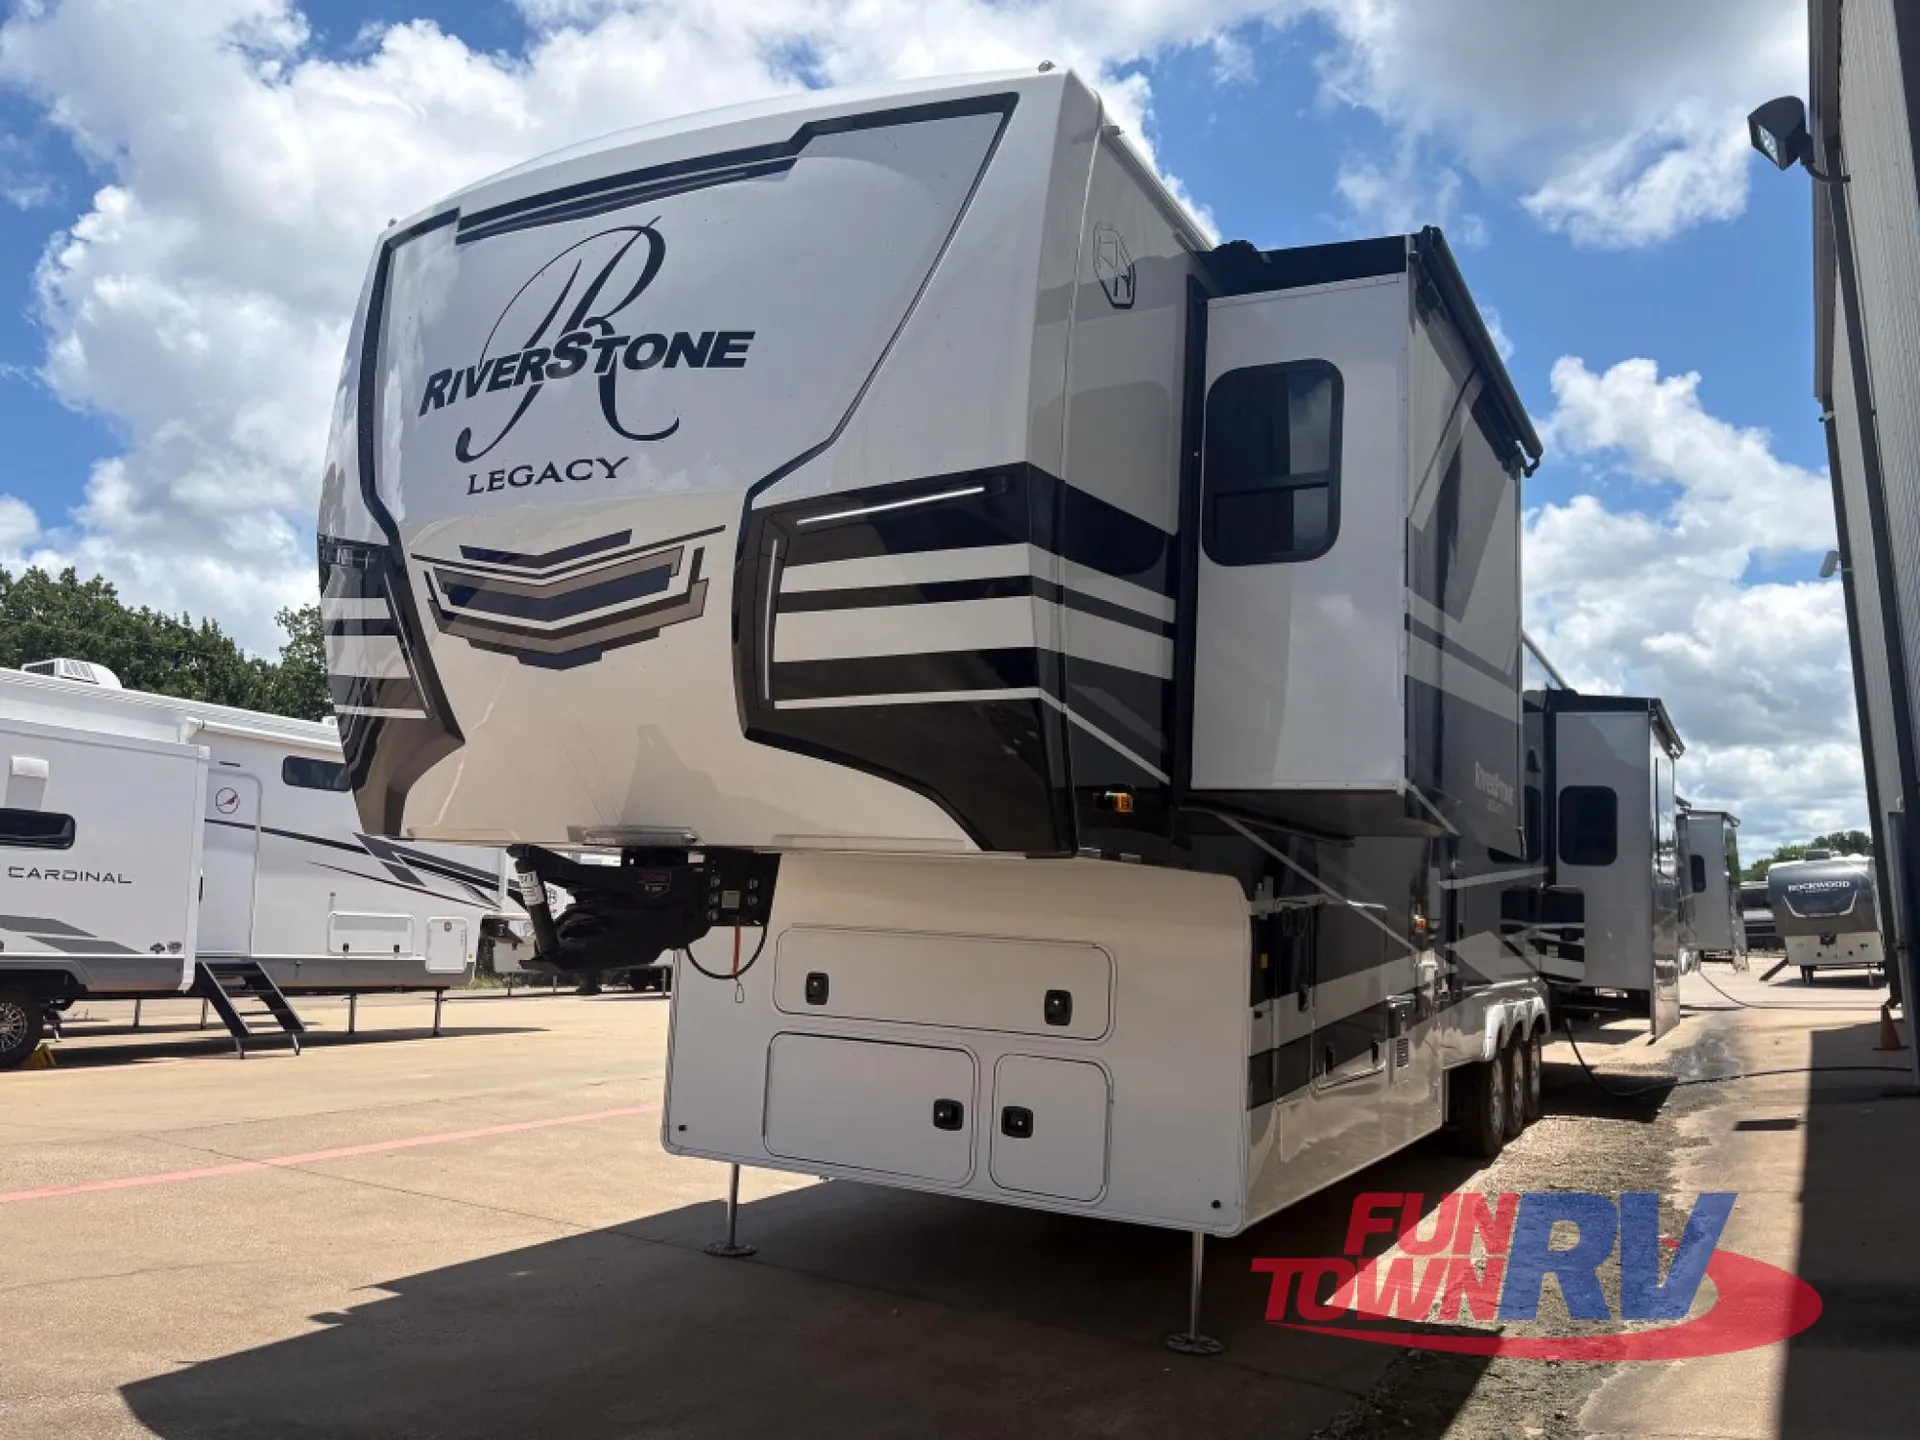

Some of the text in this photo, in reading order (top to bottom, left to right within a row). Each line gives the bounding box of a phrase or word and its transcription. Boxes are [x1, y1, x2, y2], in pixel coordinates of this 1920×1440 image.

[418, 329, 756, 417] RIVERSTONE
[467, 456, 629, 496] LEGACY
[8, 865, 133, 884] CARDINAL
